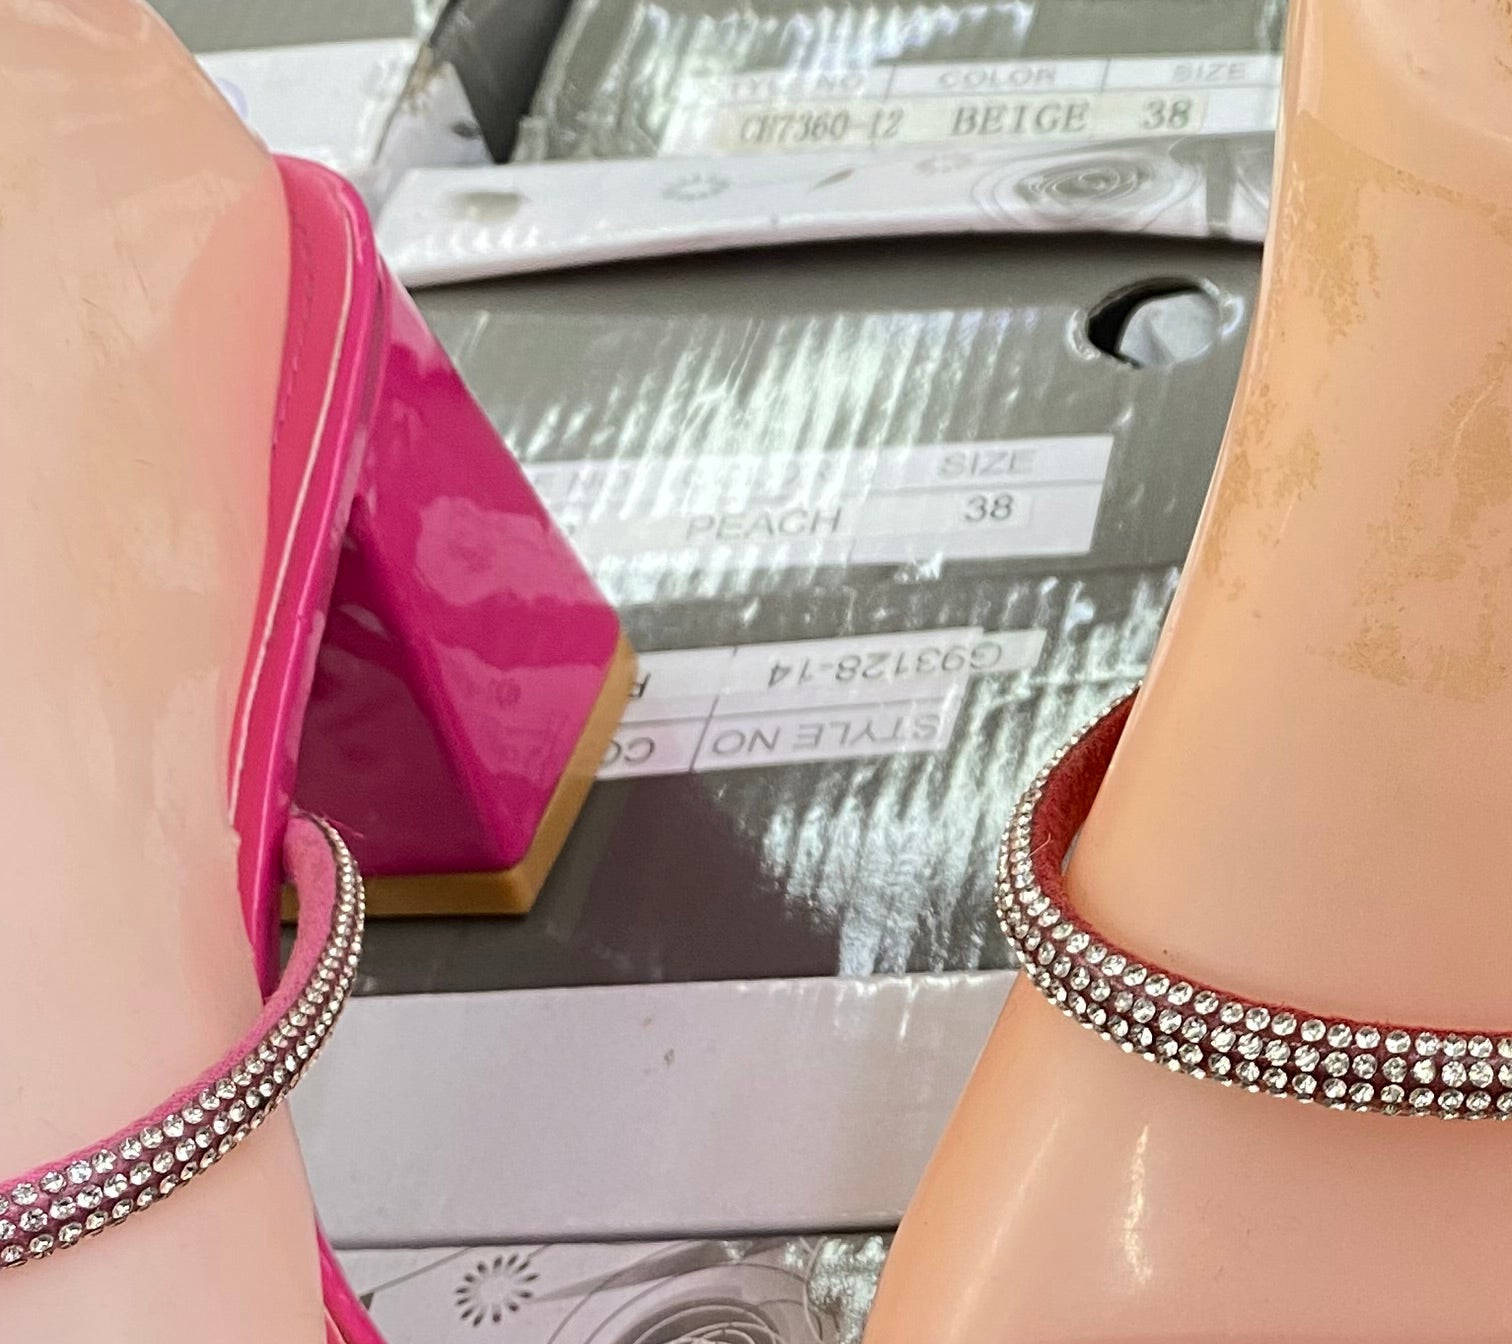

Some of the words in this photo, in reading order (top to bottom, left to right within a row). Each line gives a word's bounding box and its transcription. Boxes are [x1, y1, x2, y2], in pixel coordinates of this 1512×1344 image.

[938, 67, 1057, 90] COLOR
[1172, 62, 1246, 84] SIZE
[951, 100, 1091, 137] BEIGE
[1142, 98, 1193, 131] 38
[936, 448, 1038, 478] SIZE
[686, 507, 843, 542] PEACH
[963, 493, 1015, 523] 38
[767, 640, 1003, 689] G93128-14
[711, 726, 781, 757] NO
[793, 712, 941, 751] STYLE
